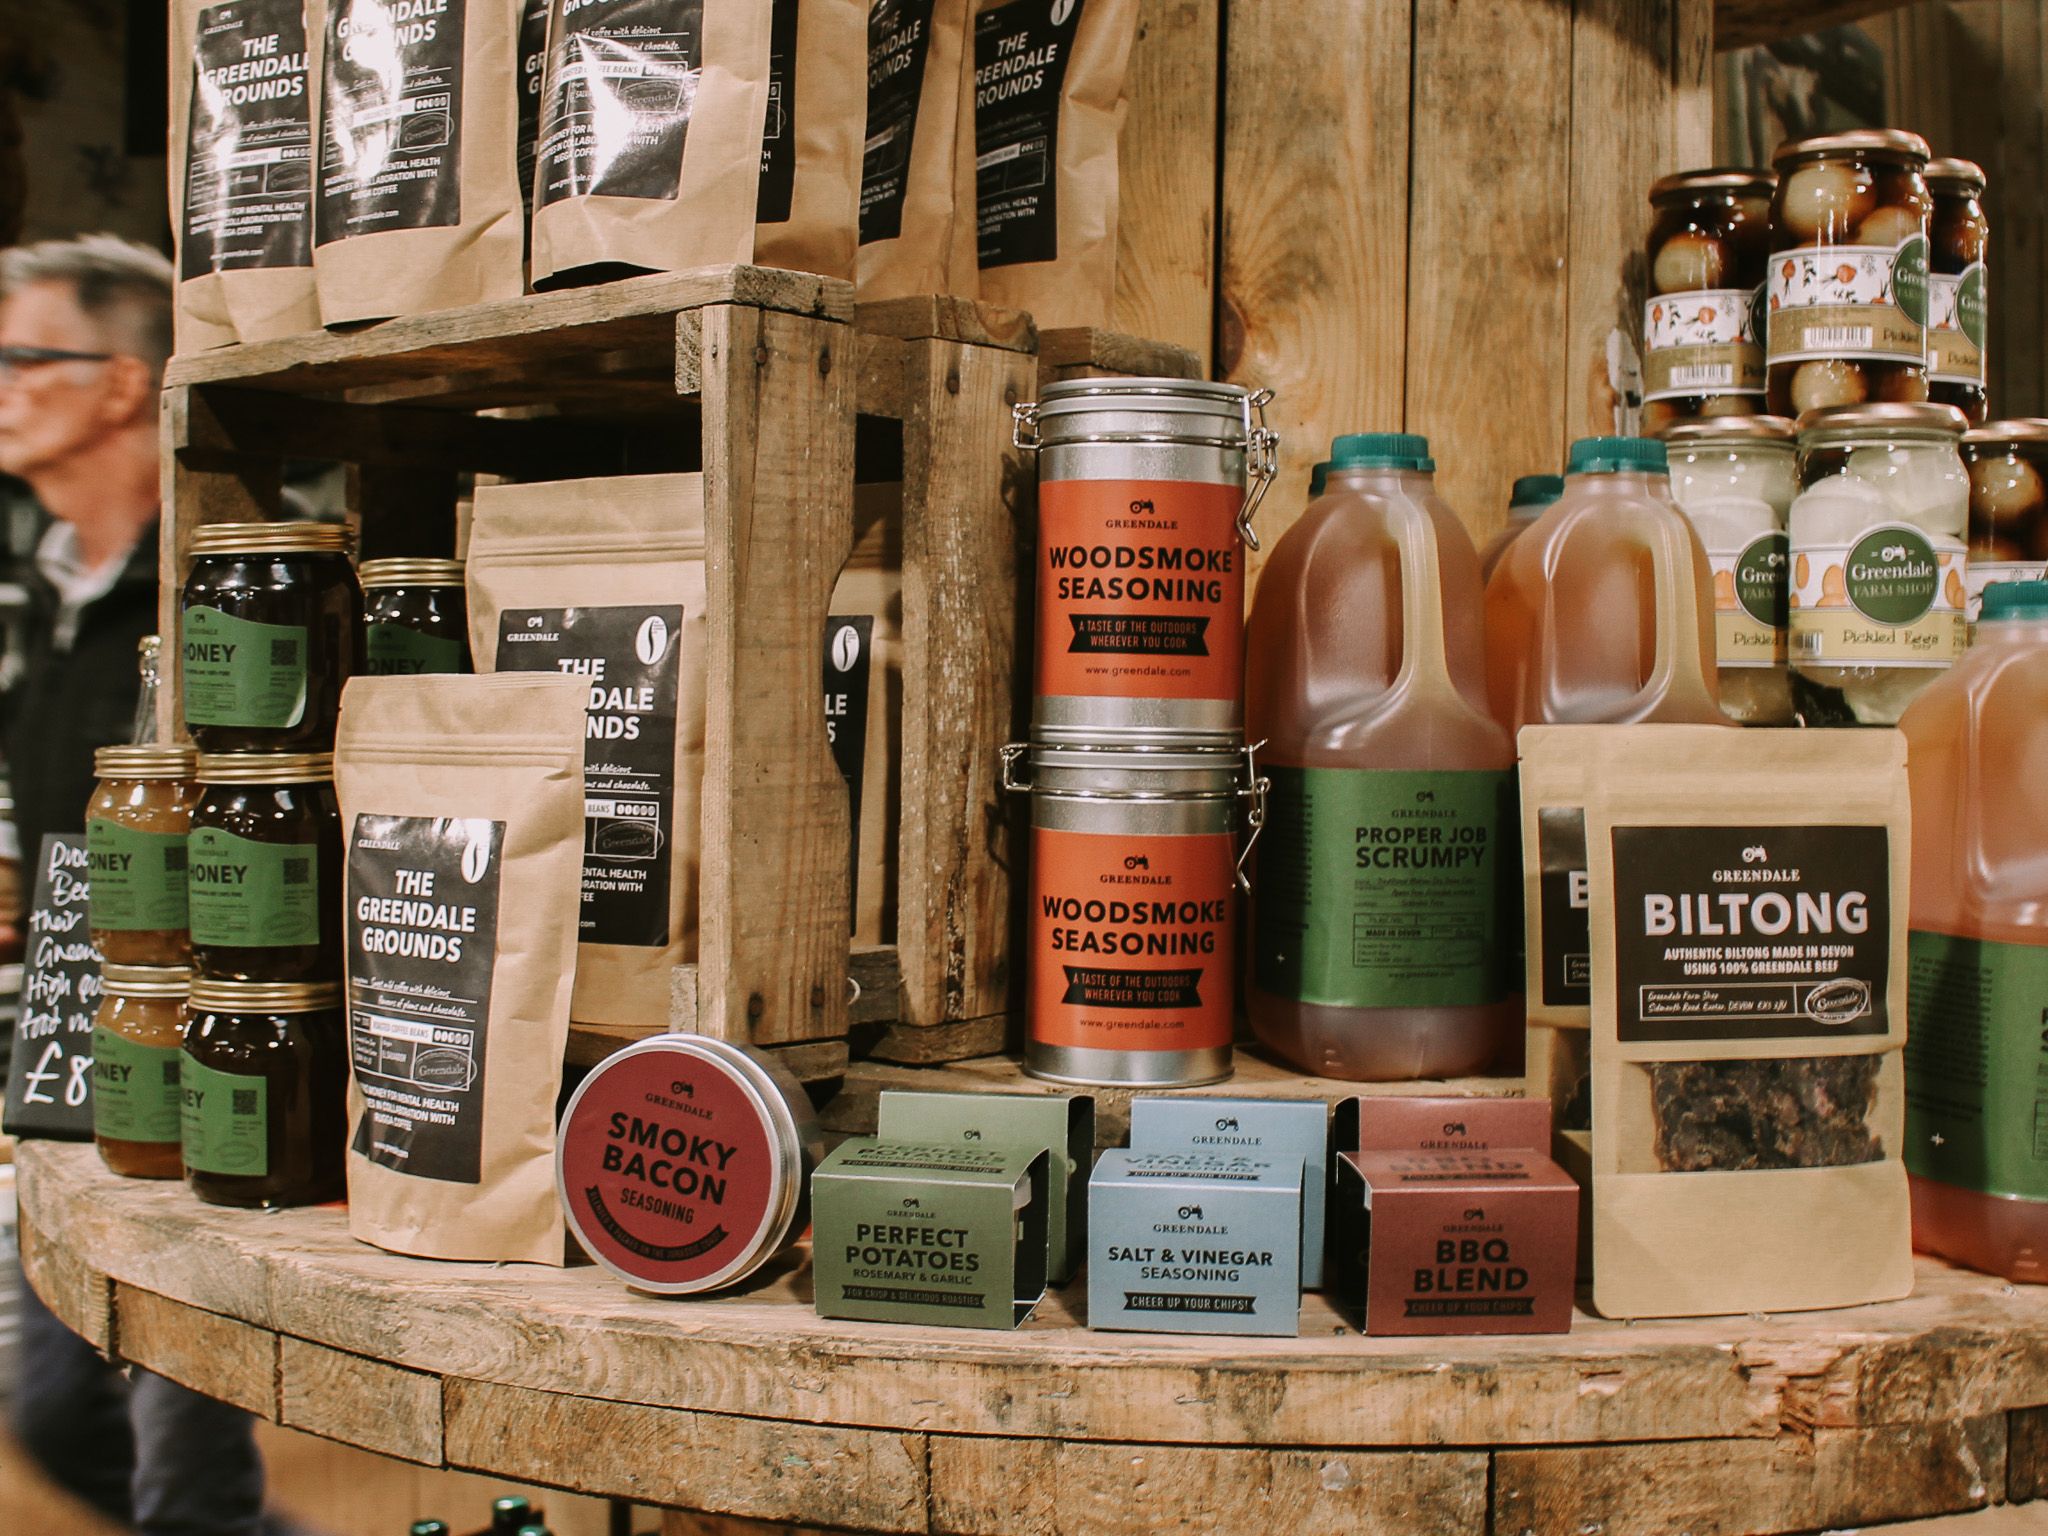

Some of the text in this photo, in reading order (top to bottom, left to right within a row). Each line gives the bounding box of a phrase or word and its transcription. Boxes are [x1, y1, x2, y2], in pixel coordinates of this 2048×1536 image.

[242, 34, 279, 58] THE
[998, 31, 1029, 57] THE
[976, 43, 1058, 87] REENDALE
[222, 76, 304, 106] ROUNDS
[977, 69, 1045, 110] ROUNDS
[409, 157, 441, 169] HEALTH
[417, 168, 438, 179] WITH
[1106, 520, 1178, 530] GREENDALE
[1050, 546, 1232, 573] WOODSMOKE
[1852, 561, 1933, 581] Greendale
[1058, 577, 1221, 603] SEASONING
[1854, 582, 1933, 598] FARM SHOP
[1079, 620, 1196, 634] A TASTE OF THE OUTDOORS
[507, 633, 559, 642] GREENDALE
[1090, 635, 1188, 648] WHEREVER YOU COOK
[1843, 629, 1939, 650] Pickled Eggs
[558, 658, 606, 681] THE
[1085, 666, 1191, 677] www.greendale.com
[588, 804, 610, 816] BEANS
[1392, 809, 1457, 819] GREENDALE
[1355, 826, 1487, 844] PROPER JOB
[358, 838, 400, 851] GREENDALE
[88, 853, 133, 873] ONEY
[1355, 846, 1485, 869] SCRUMPY
[609, 868, 647, 880] HEALTH
[1100, 874, 1172, 885] GREENDALE
[1712, 869, 1800, 883] GREENDALE
[395, 870, 435, 897] THE
[617, 881, 643, 893] WITH
[357, 896, 476, 933] GREENDALE
[1043, 895, 1225, 925] WOODSMOKE
[1645, 891, 1868, 936] BILTONG
[362, 927, 462, 962] GROUNDS
[1052, 927, 1214, 956] SEASONING
[1664, 945, 1854, 961] AUTHENTIC BILTONG MADE IN DEVON
[1684, 960, 1839, 975] USING 100% GREENDALE BEEF
[1073, 972, 1191, 987] A TASTE OF THE OUTDOORS
[1084, 988, 1180, 1002] WHEREVER YOU COOK
[1080, 1020, 1184, 1031] www.greendale.com
[95, 1063, 133, 1082] NEY
[422, 1097, 460, 1112] HEALTH
[645, 1093, 713, 1121] GREENDALE
[430, 1111, 456, 1125] WITH
[607, 1112, 737, 1171] SMOKY
[1192, 1135, 1262, 1146] GREENDALE
[1420, 1141, 1488, 1150] GREENDALE
[602, 1144, 727, 1206] BACON
[621, 1188, 694, 1224] SEASONING
[887, 1209, 936, 1219] GREENDALE
[857, 1223, 968, 1249] PERFECT
[1153, 1223, 1229, 1235] GREENDALE
[1442, 1224, 1504, 1233] GREENDALE
[846, 1246, 979, 1272] POTATOES
[1108, 1246, 1273, 1266] SALT & VINEGAR
[1436, 1239, 1510, 1264] BBQ
[853, 1268, 973, 1285] ROSEMARY & GARLIC
[1141, 1267, 1240, 1282] SEASONING
[1414, 1267, 1529, 1293] BLEND
[847, 1288, 863, 1297] FOR
[865, 1289, 887, 1298] CRISP
[899, 1290, 940, 1302] DELICIOUS
[1131, 1295, 1249, 1311] CHEER UP YOUR CHIPS!
